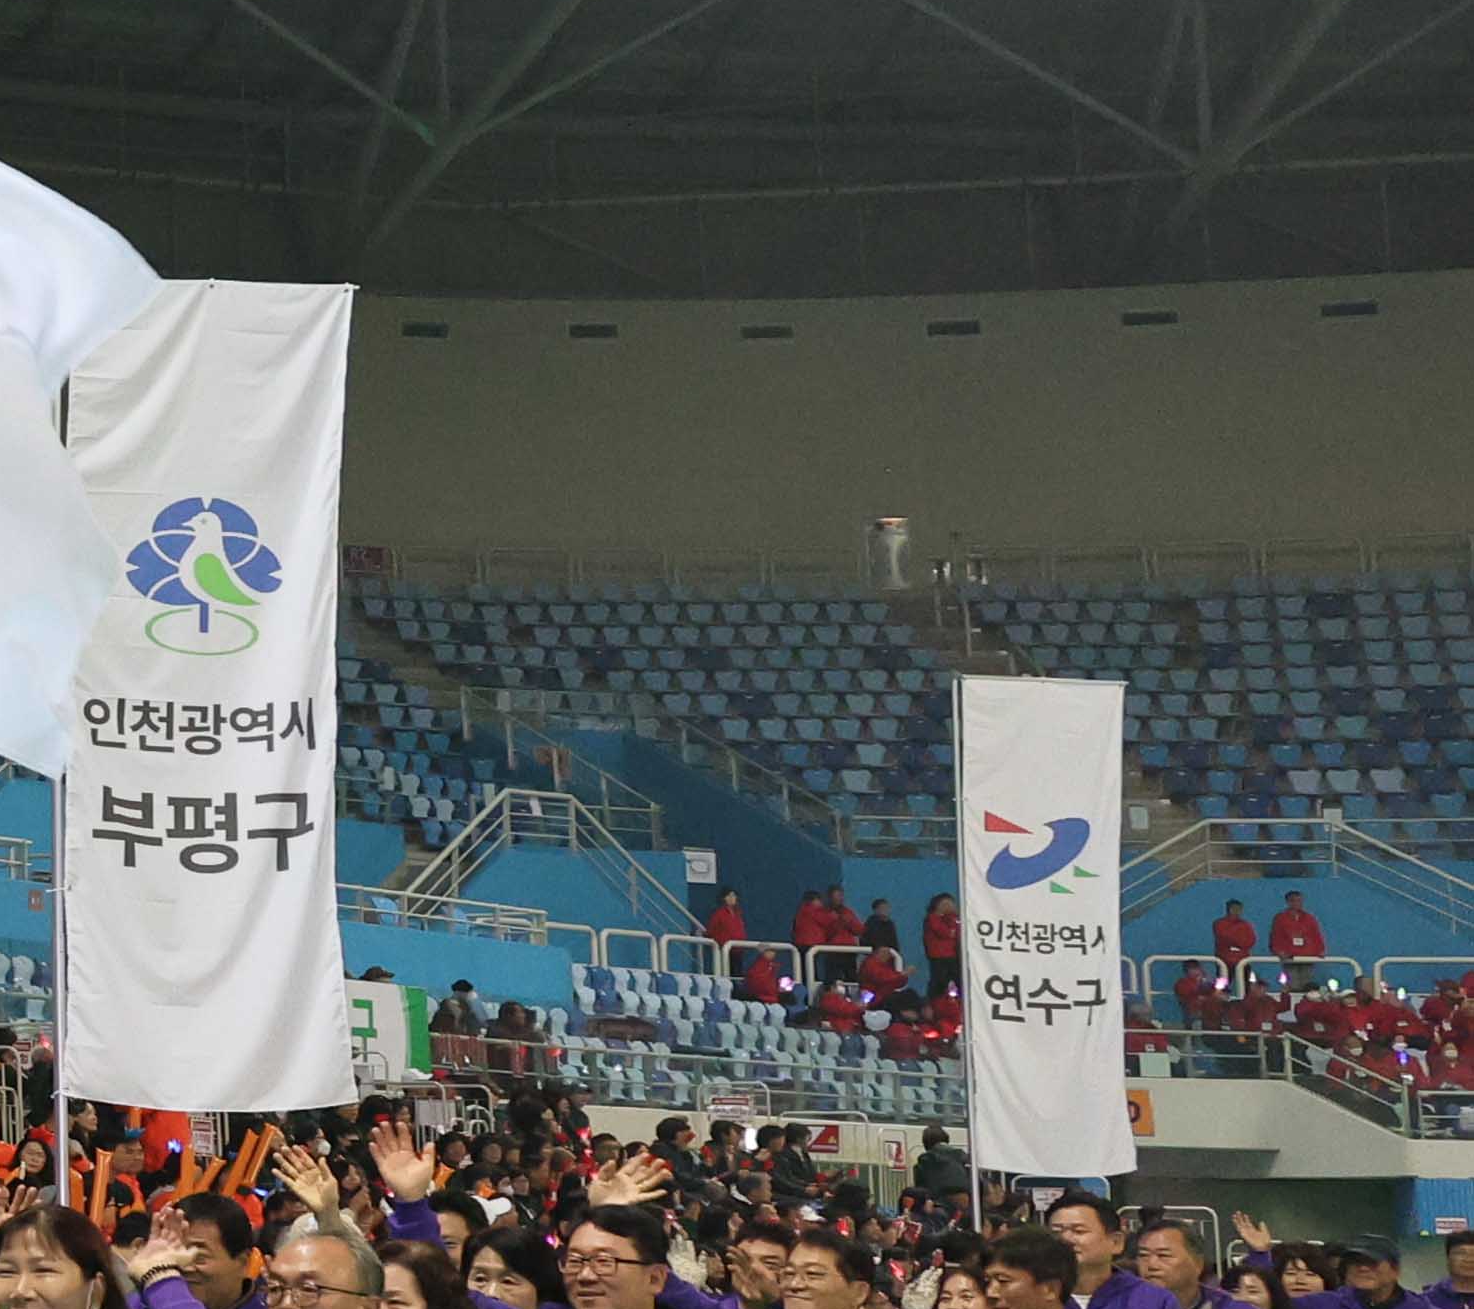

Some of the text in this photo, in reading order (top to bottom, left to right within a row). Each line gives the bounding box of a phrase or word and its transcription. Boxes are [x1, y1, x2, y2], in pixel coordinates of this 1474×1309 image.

[83, 697, 316, 755] 인천광역시
[92, 785, 314, 874] 부평구
[985, 974, 1107, 1026] 연수구
